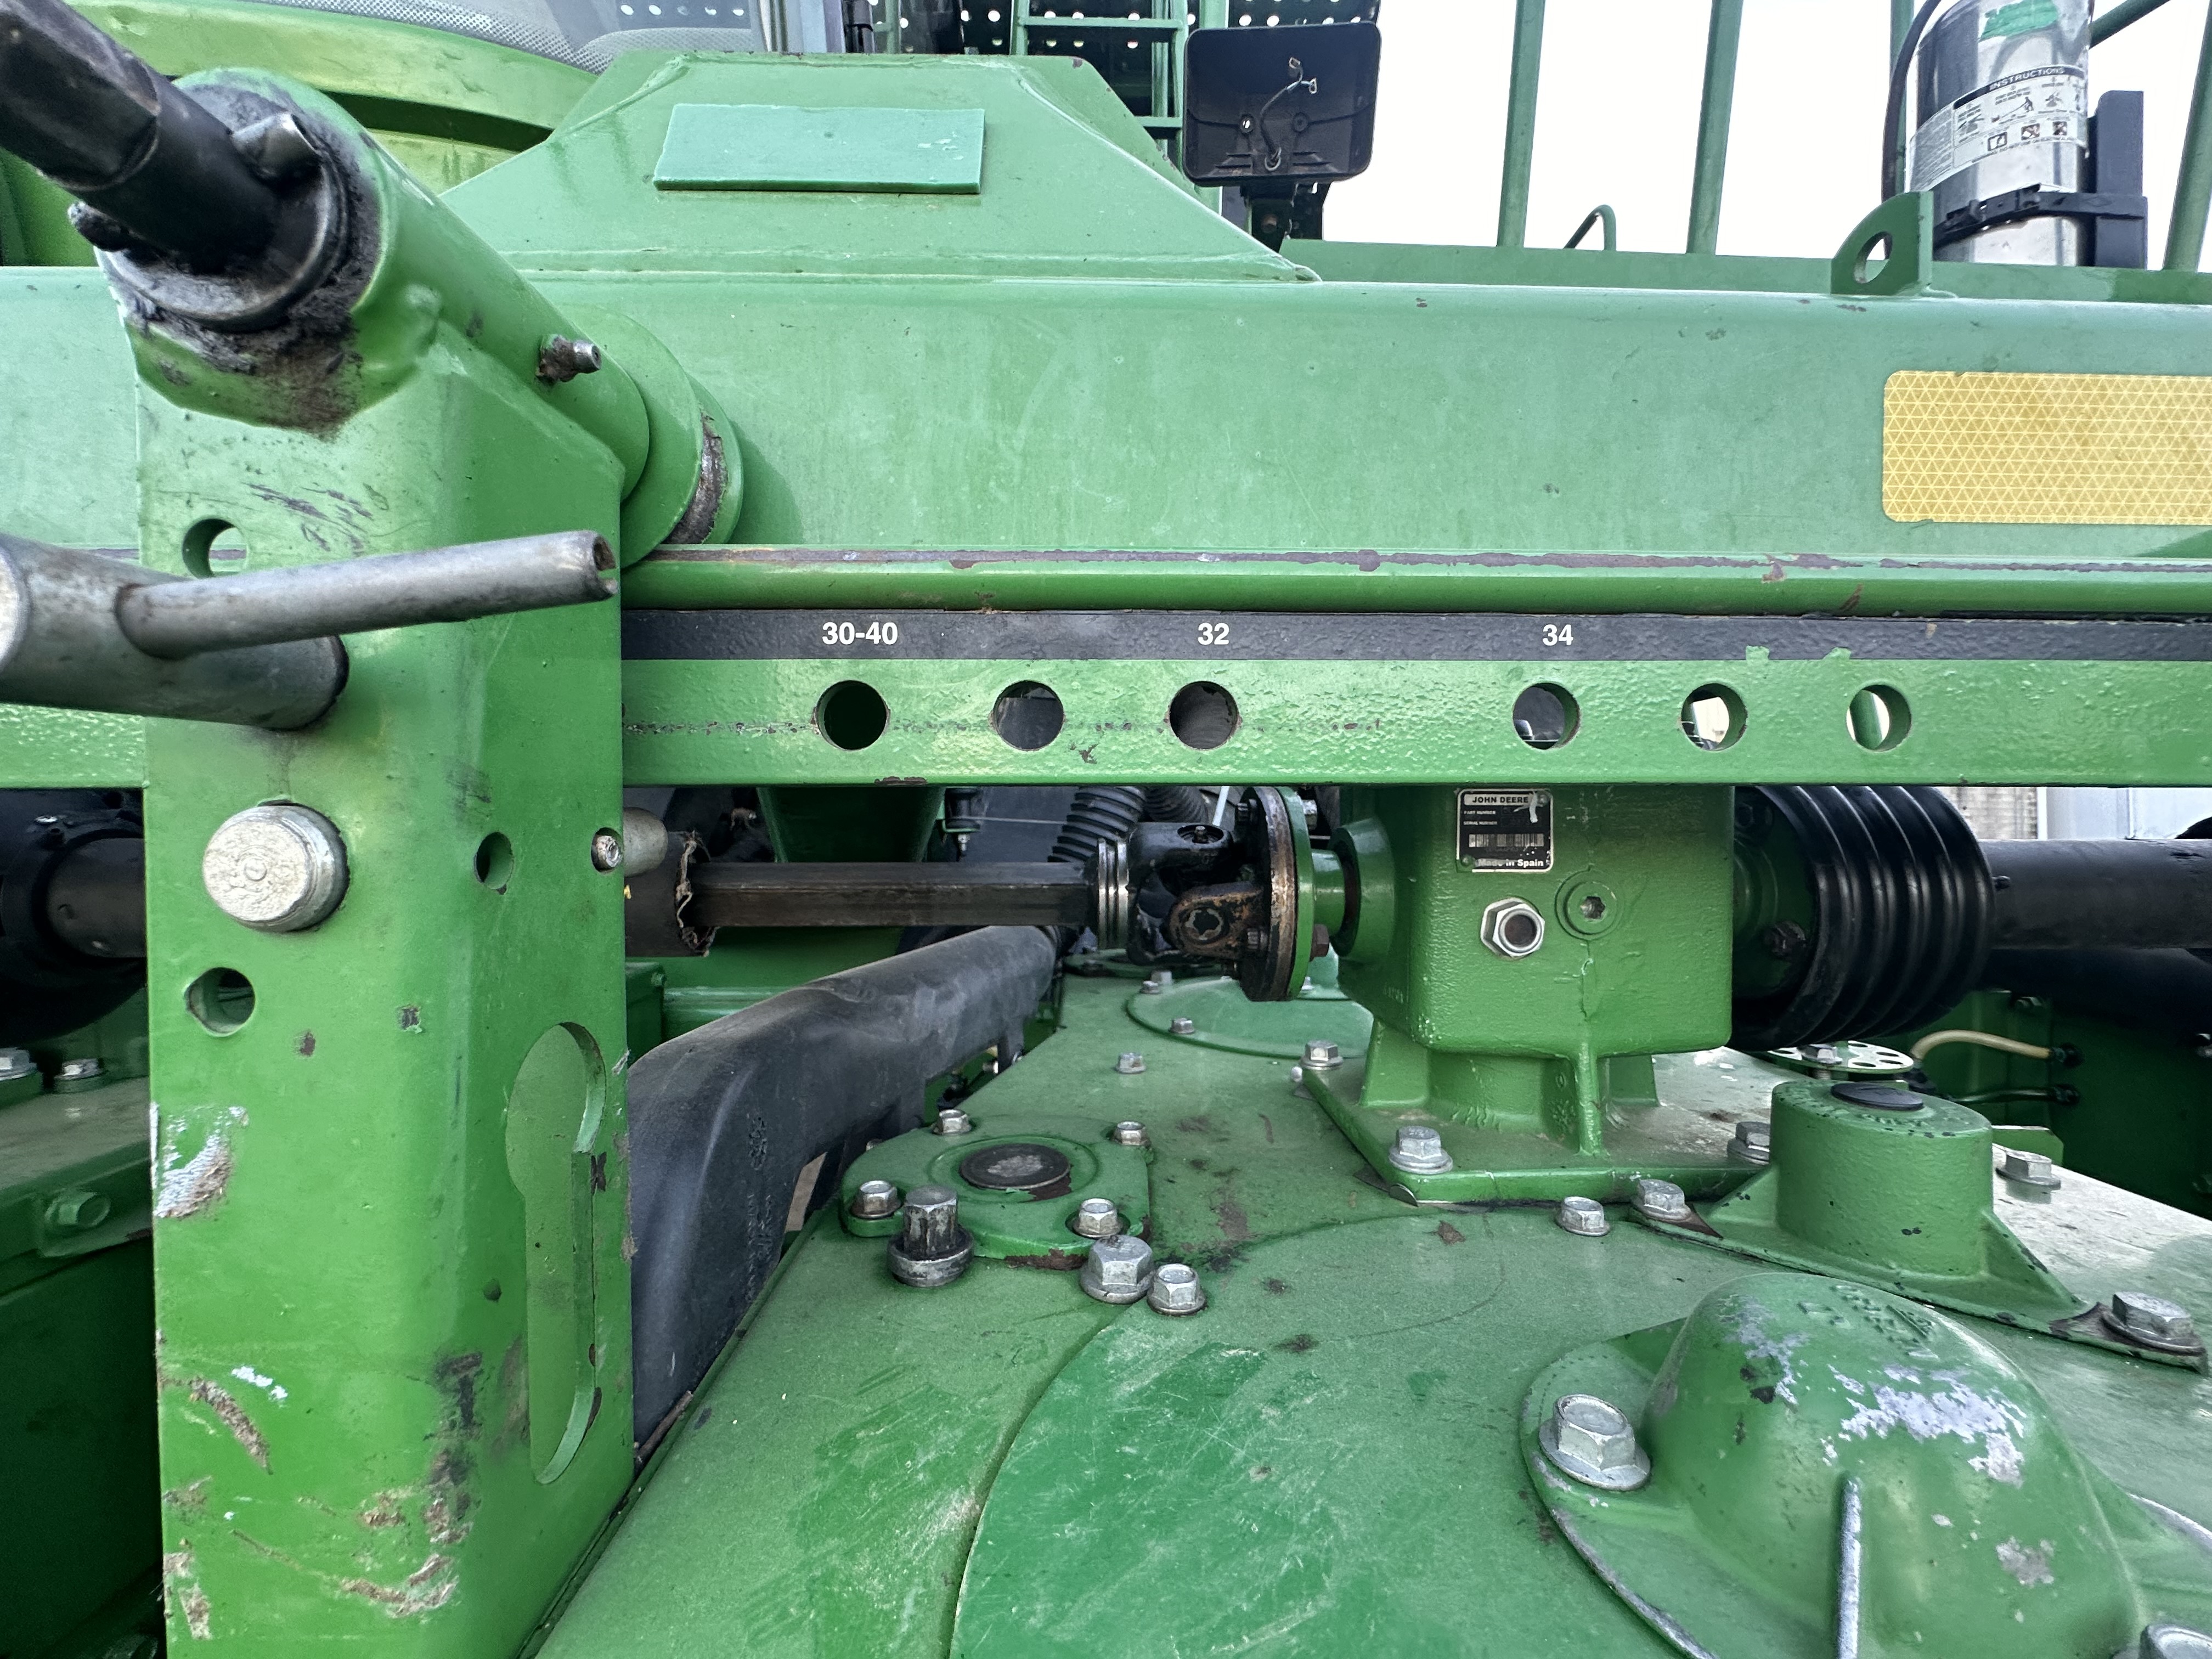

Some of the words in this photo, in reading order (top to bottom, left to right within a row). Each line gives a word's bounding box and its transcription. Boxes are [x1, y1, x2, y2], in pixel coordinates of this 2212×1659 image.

[1989, 67, 2065, 91] INSTRUCTIONS
[822, 622, 898, 645] 30-40
[1198, 622, 1229, 646] 32
[1542, 624, 1574, 646] 34
[1505, 859, 1515, 867] in
[1517, 859, 1544, 868] Spain
